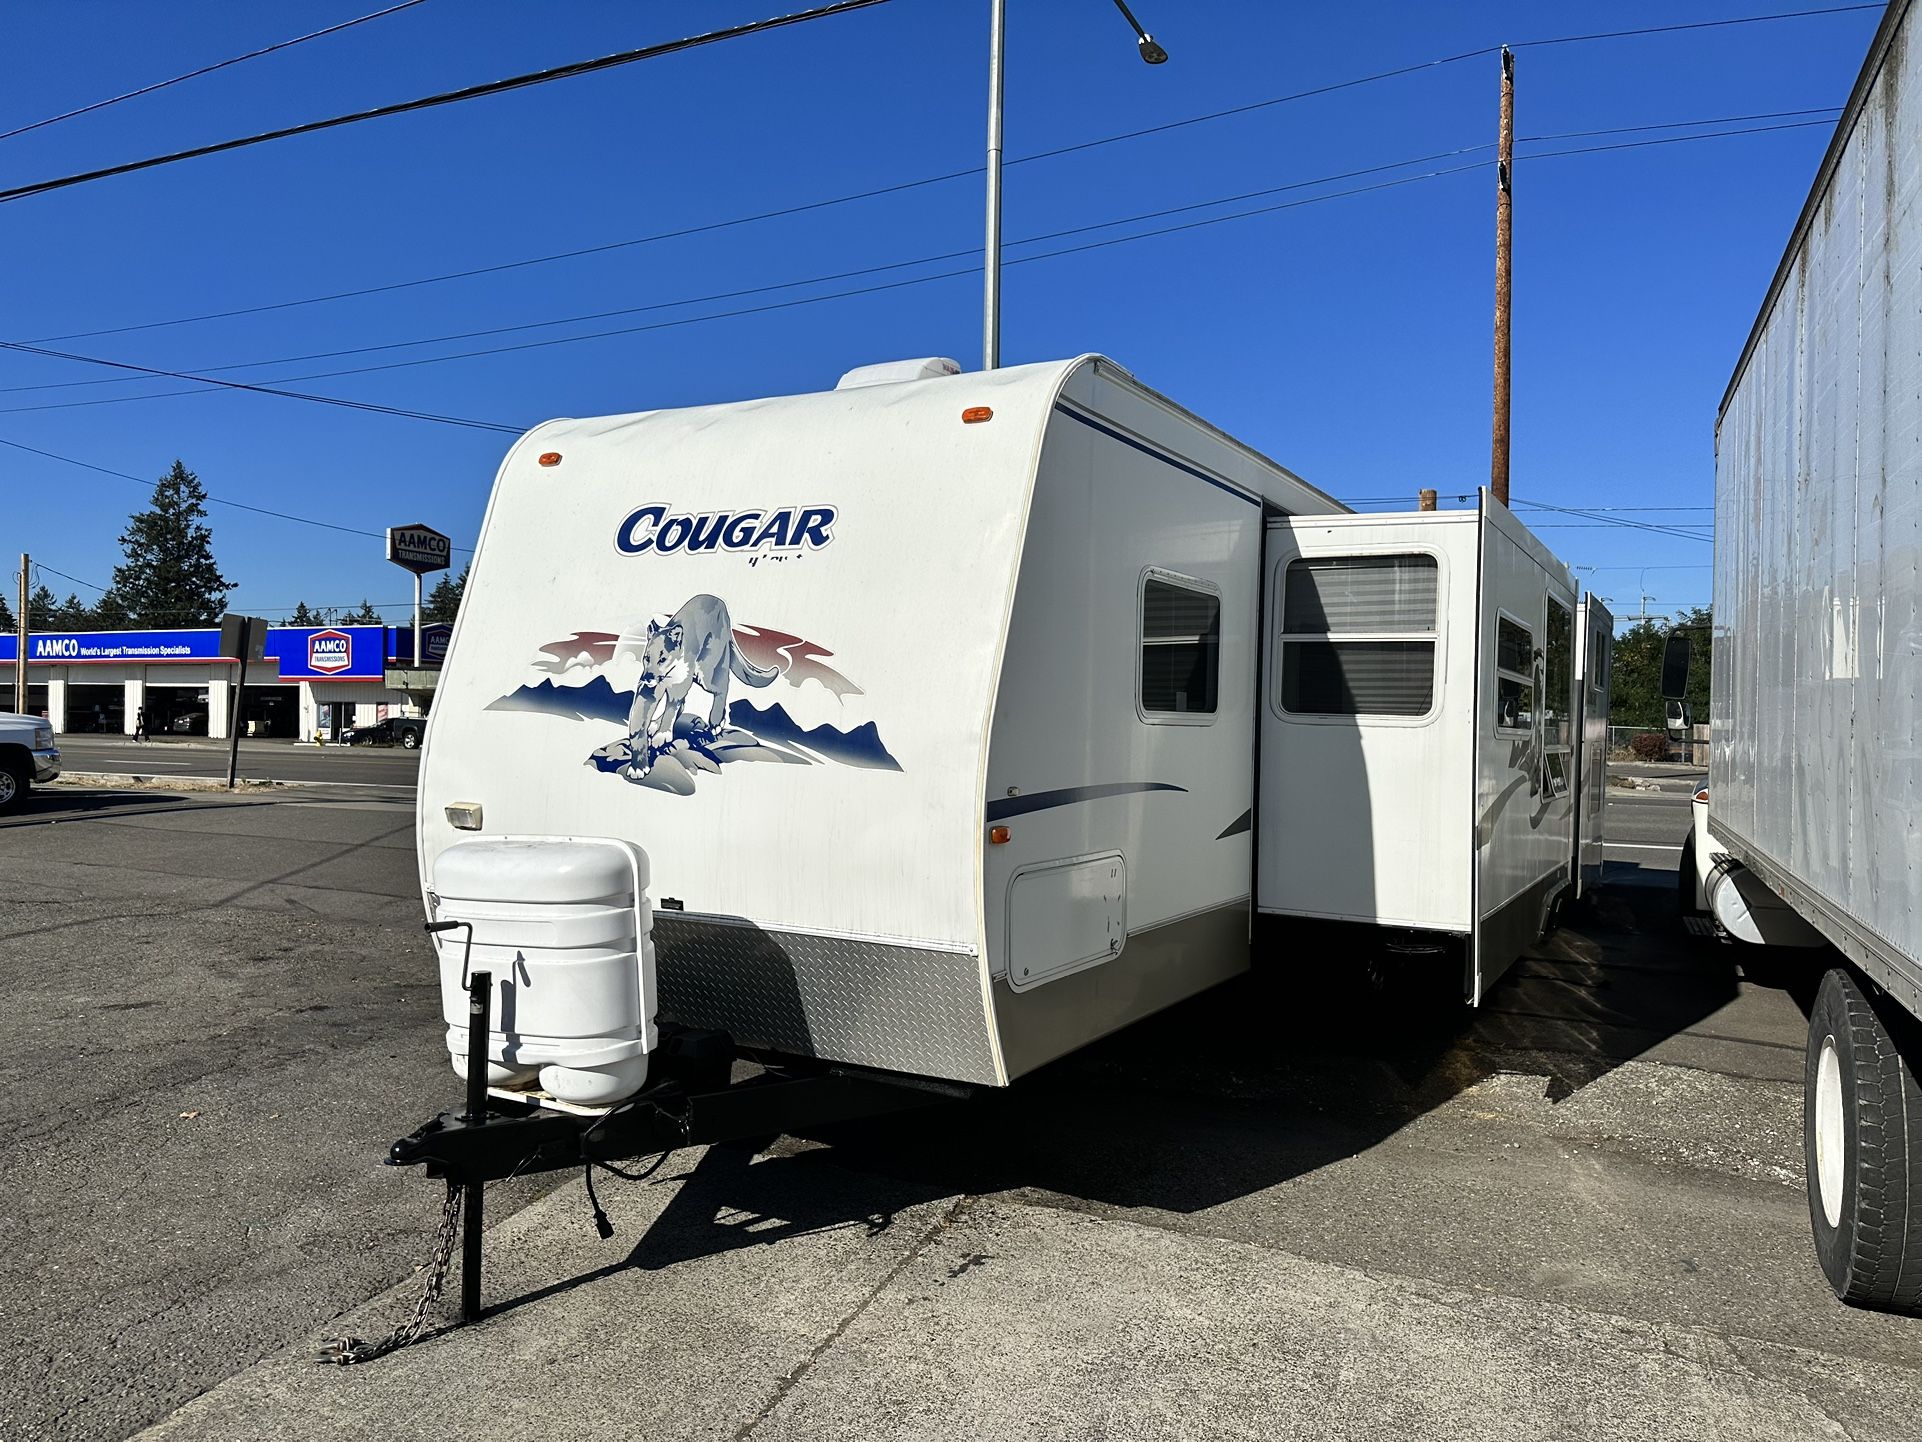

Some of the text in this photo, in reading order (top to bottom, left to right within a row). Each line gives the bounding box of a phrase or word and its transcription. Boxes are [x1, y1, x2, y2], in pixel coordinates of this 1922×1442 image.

[615, 503, 837, 556] COUGAR
[398, 532, 447, 553] AAMCO
[398, 549, 446, 565] TRANSMISSIONS
[36, 638, 191, 657] AAMCO World's Largest Transmission Specialists
[313, 639, 347, 653] AAMCO
[430, 635, 450, 645] AAMC
